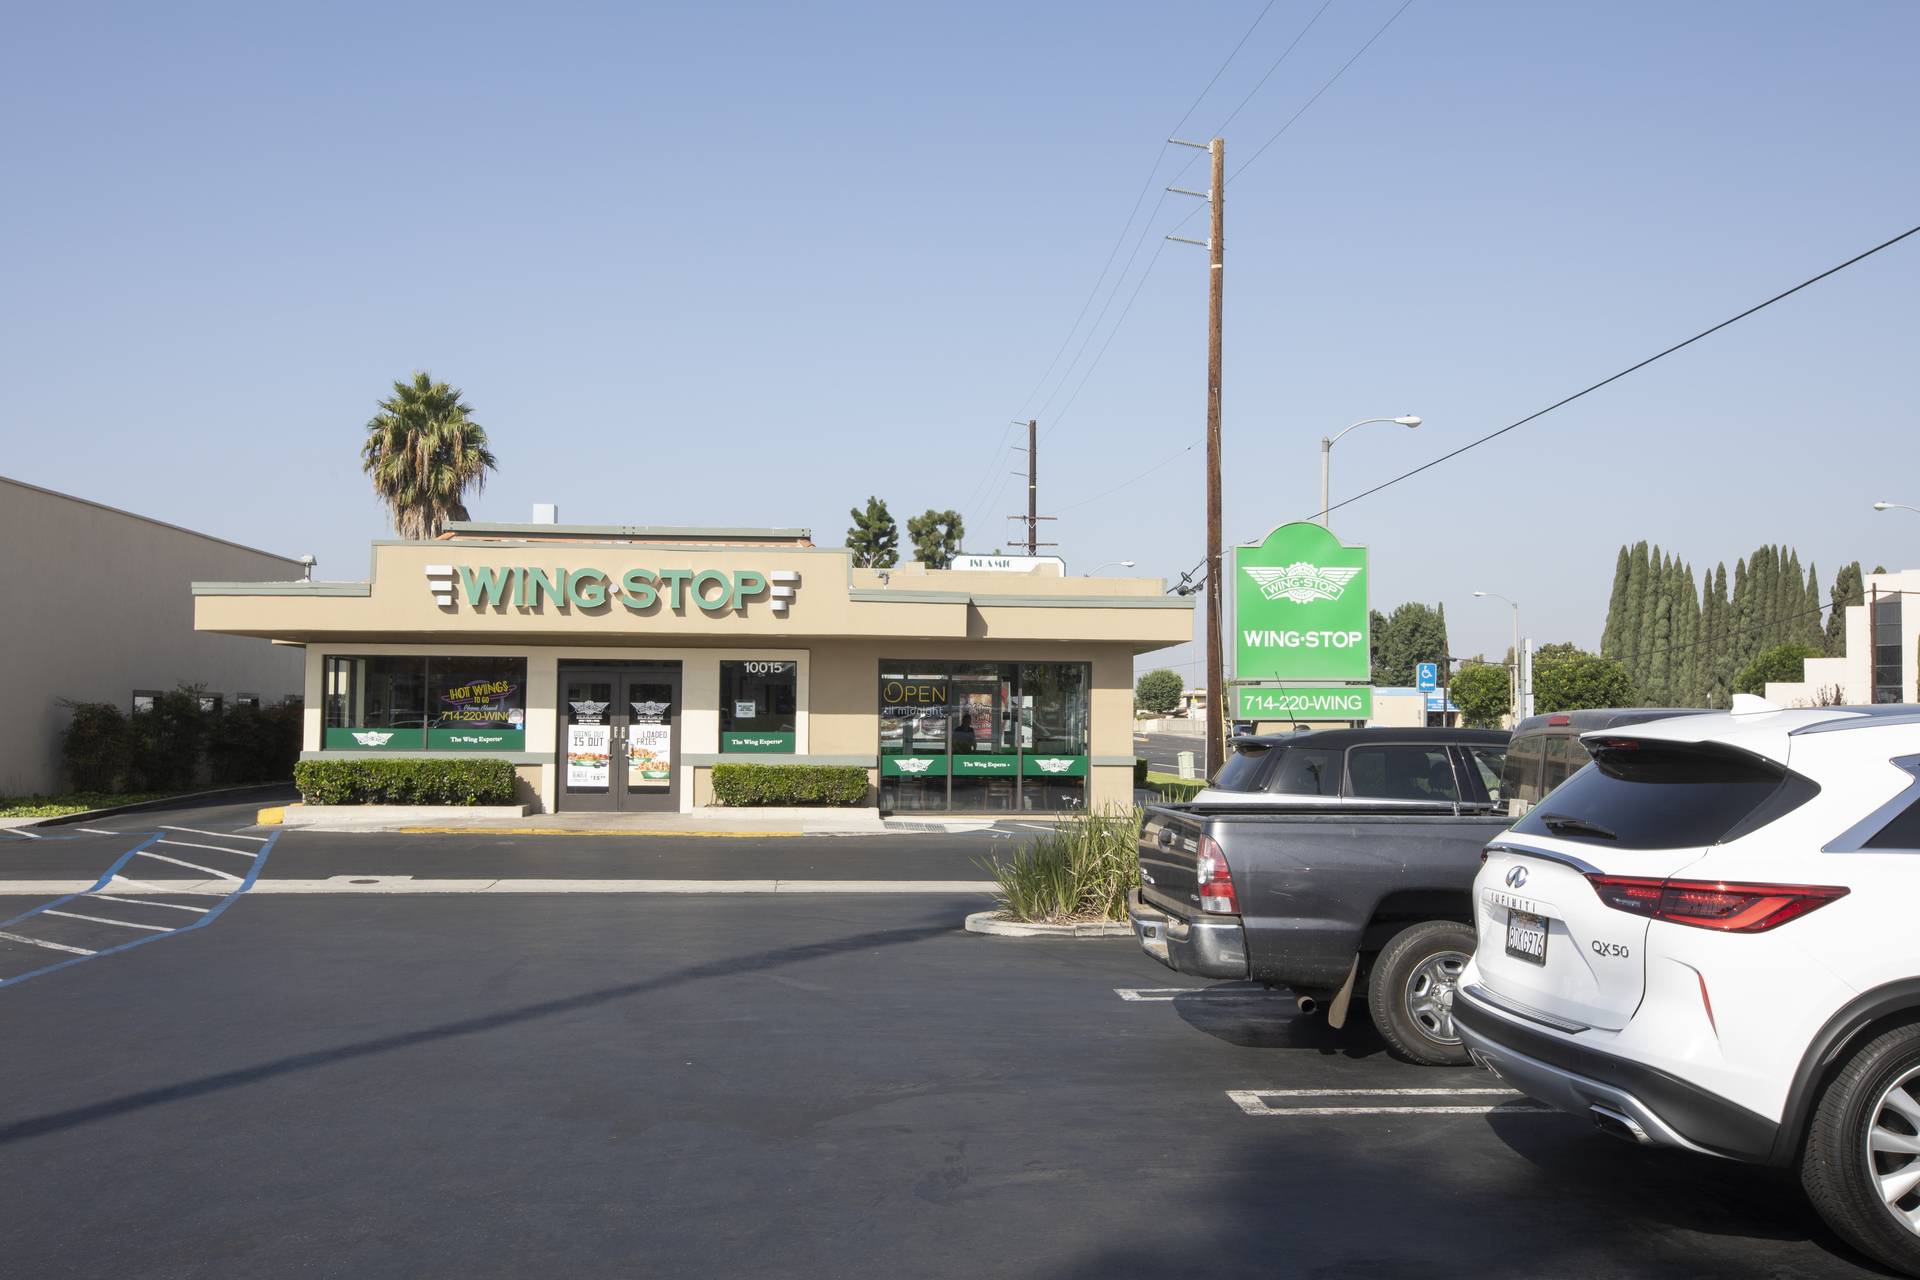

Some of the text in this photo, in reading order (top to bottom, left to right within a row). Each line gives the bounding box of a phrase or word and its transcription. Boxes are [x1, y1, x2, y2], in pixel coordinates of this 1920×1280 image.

[743, 661, 783, 673] 10015
[450, 681, 509, 700] HOT WINGS
[883, 681, 946, 703] OPEN
[897, 705, 944, 718] midnight
[1244, 695, 1362, 711] 714-220-WING
[573, 737, 604, 746] IS OUT
[642, 731, 667, 739] LOADED
[1491, 892, 1536, 912] INFINITI
[1508, 926, 1544, 957] 8DKG976
[1591, 940, 1629, 958] QX50
